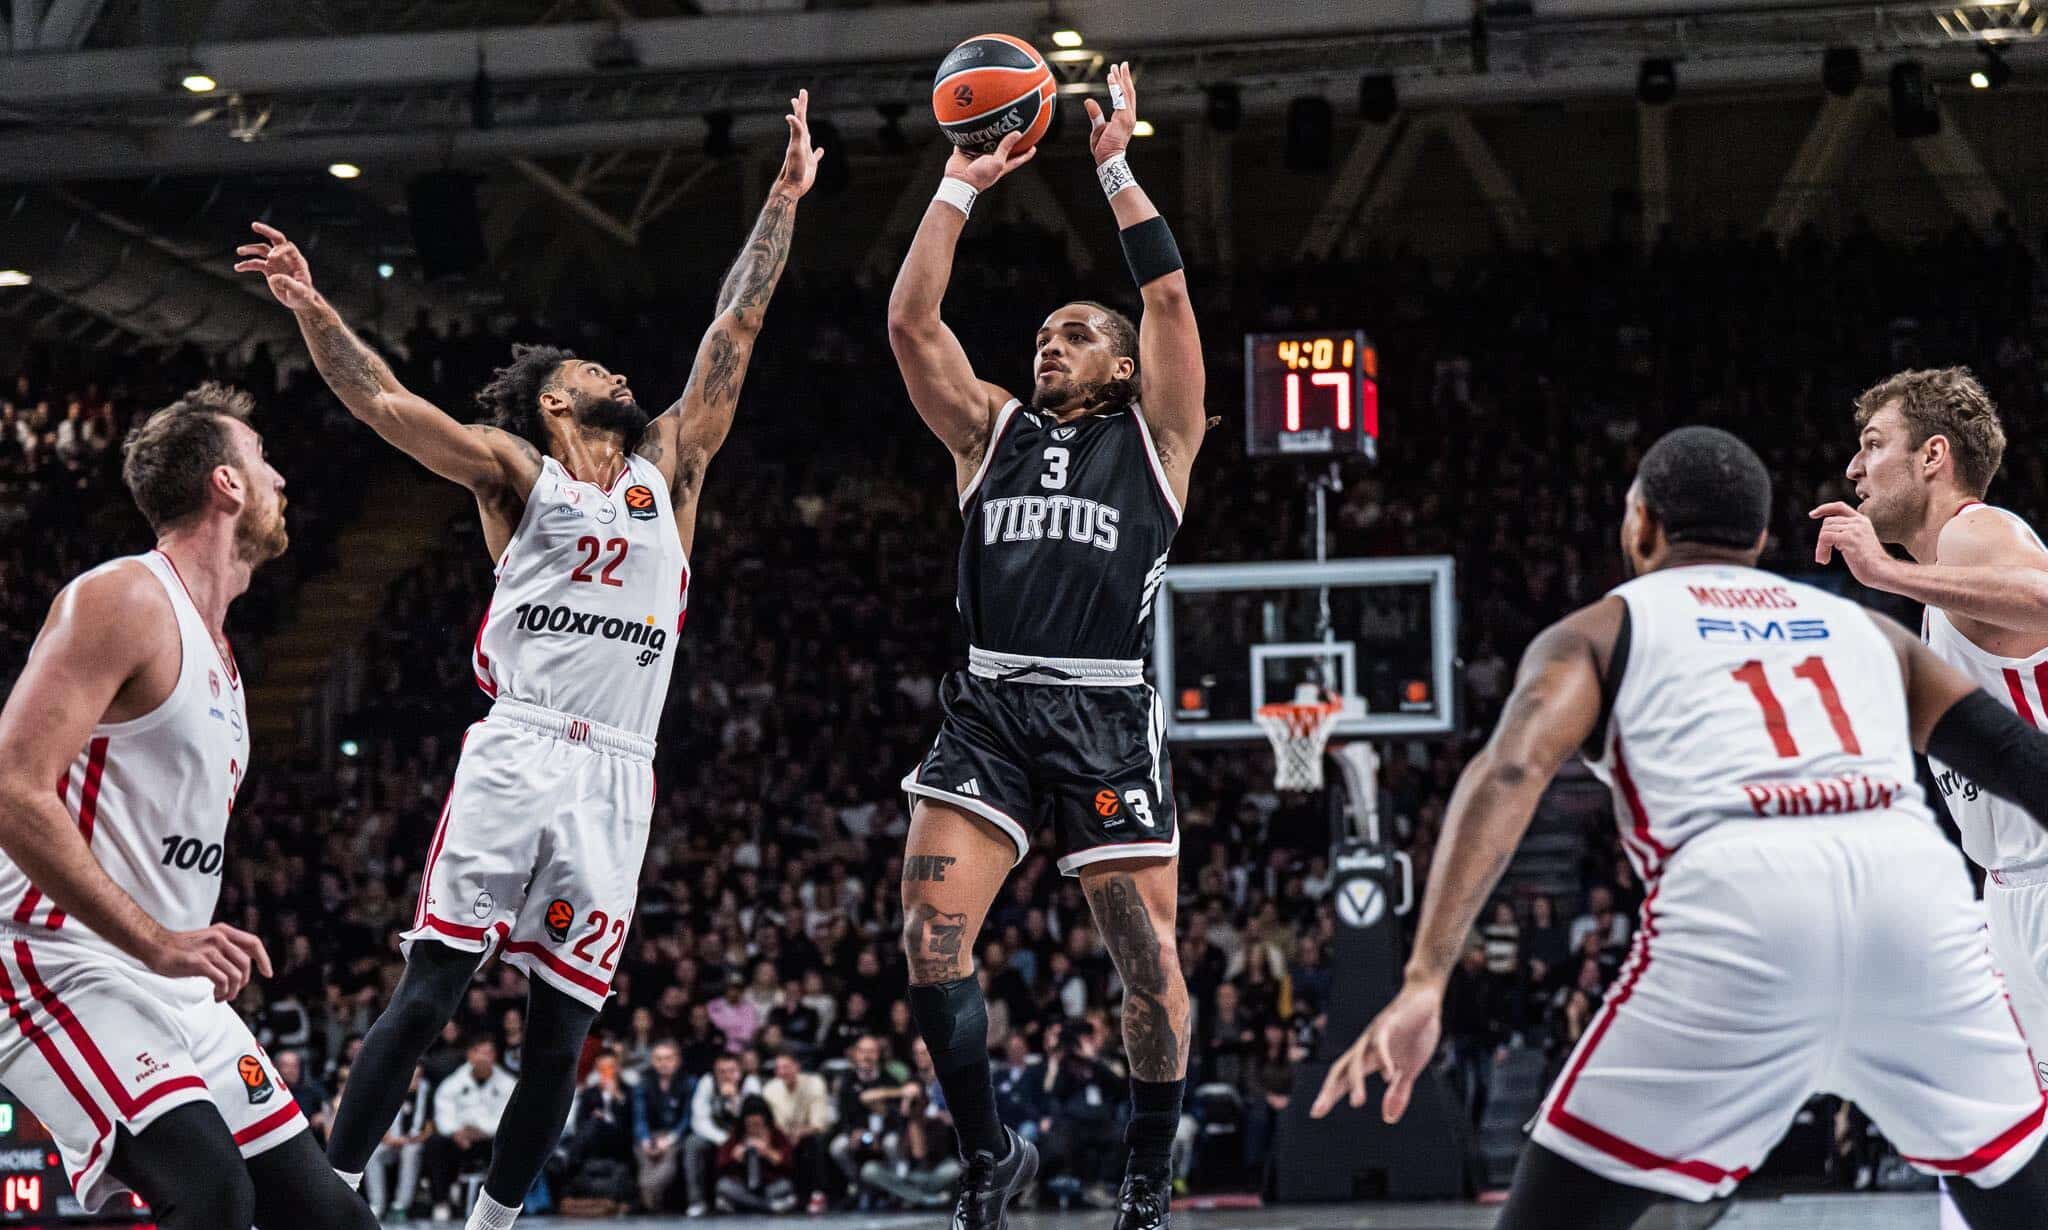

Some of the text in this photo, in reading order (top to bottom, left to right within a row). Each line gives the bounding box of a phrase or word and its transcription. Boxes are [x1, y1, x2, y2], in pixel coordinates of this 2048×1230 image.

[1278, 339, 1354, 369] 4:01
[1286, 372, 1350, 431] 17
[1041, 447, 1070, 489] 3
[983, 495, 1120, 551] VIRTUS
[571, 536, 629, 587] 22
[1688, 585, 1797, 610] MORRIS
[515, 604, 667, 651] 100xronia
[1697, 618, 1830, 641] FMS
[636, 650, 661, 667] .gr
[1730, 655, 1862, 758] 11
[1124, 789, 1155, 827] 3
[161, 835, 223, 876] 100
[572, 911, 625, 970] 22
[5, 1176, 40, 1212] 14
